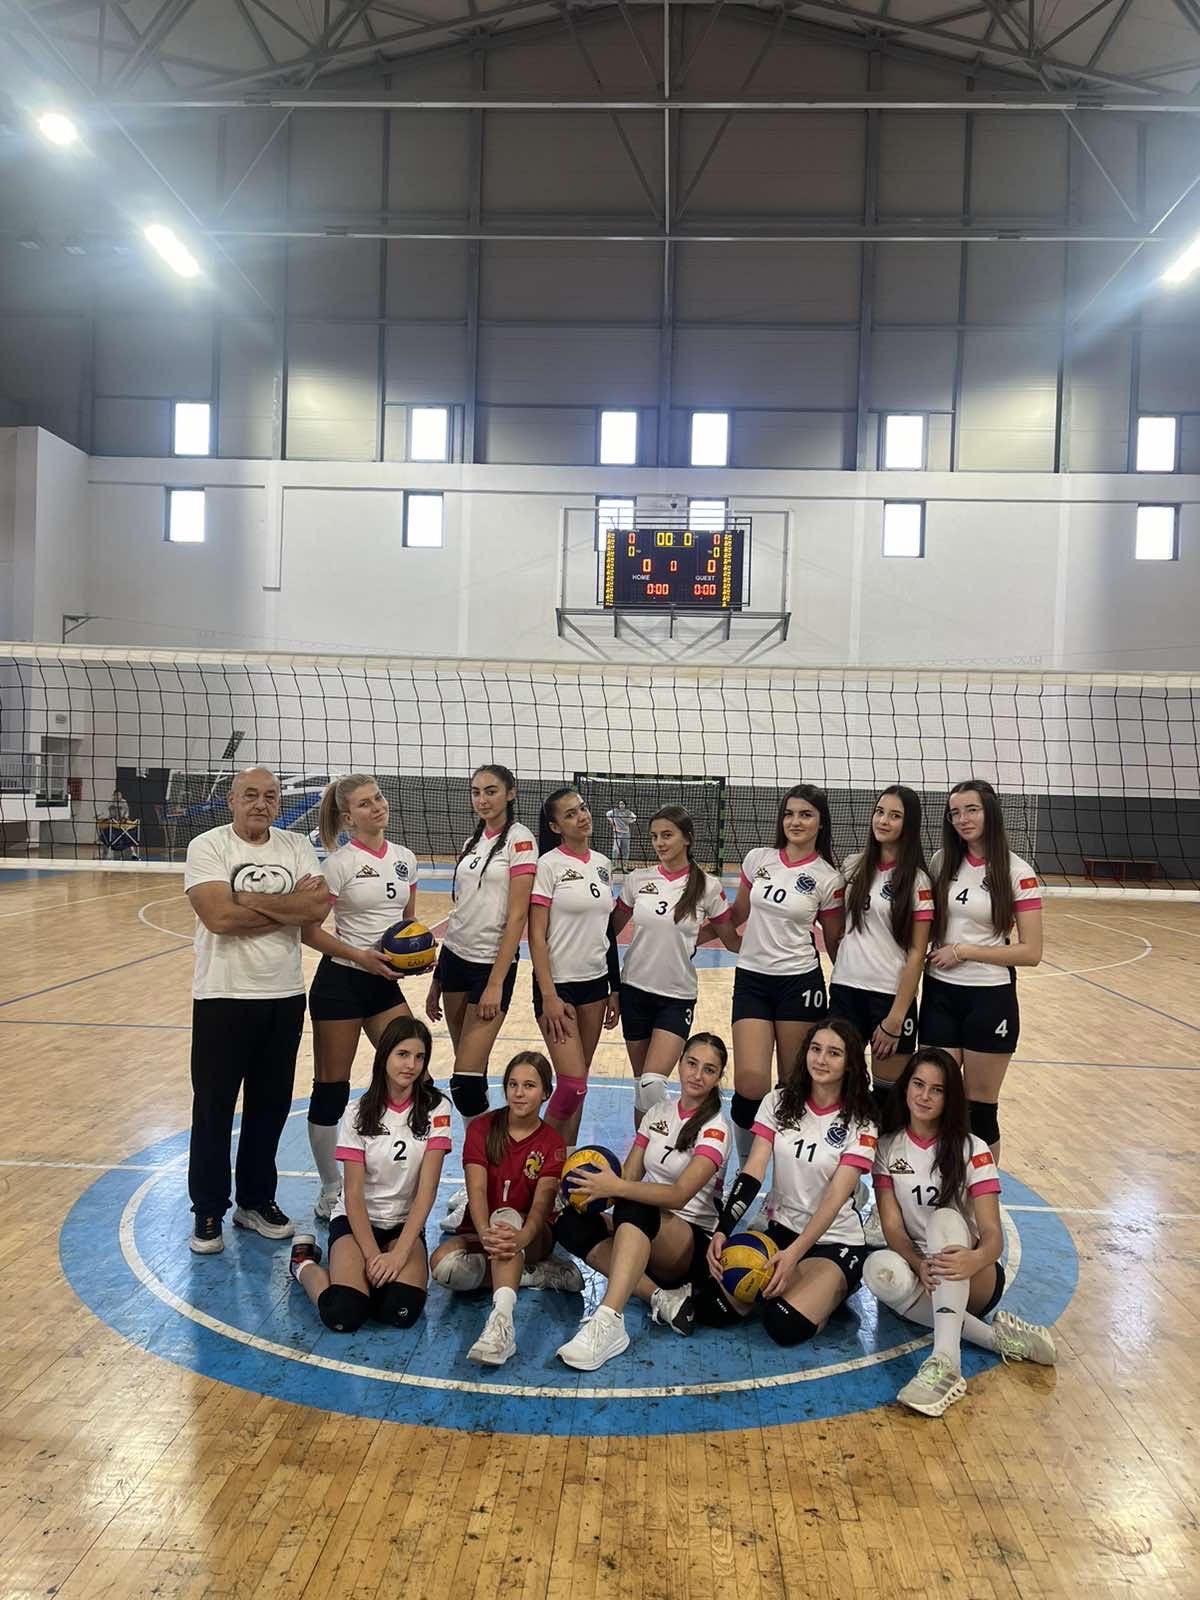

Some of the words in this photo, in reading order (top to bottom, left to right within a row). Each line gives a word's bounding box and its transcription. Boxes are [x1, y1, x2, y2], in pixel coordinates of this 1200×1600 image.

[628, 532, 636, 544] 0
[713, 533, 721, 545] 0
[628, 546, 636, 557] 0
[713, 546, 721, 558] 0
[642, 558, 652, 573] 0
[670, 560, 678, 572] 0
[707, 559, 717, 573] 0
[646, 583, 670, 595] 0:00
[693, 583, 717, 595] 0:00
[470, 856, 481, 869] 8
[386, 882, 397, 899] 5
[590, 882, 601, 898] 6
[763, 884, 787, 904] 10
[955, 888, 969, 905] 4
[655, 900, 669, 916] 3
[801, 989, 823, 1008] 10
[685, 1008, 692, 1025] 3
[903, 1018, 914, 1036] 9
[995, 1018, 1008, 1038] 4
[393, 1140, 407, 1161] 2
[660, 1145, 674, 1164] 7
[793, 1138, 817, 1163] 11
[502, 1179, 511, 1202] 1
[911, 1184, 941, 1207] 12
